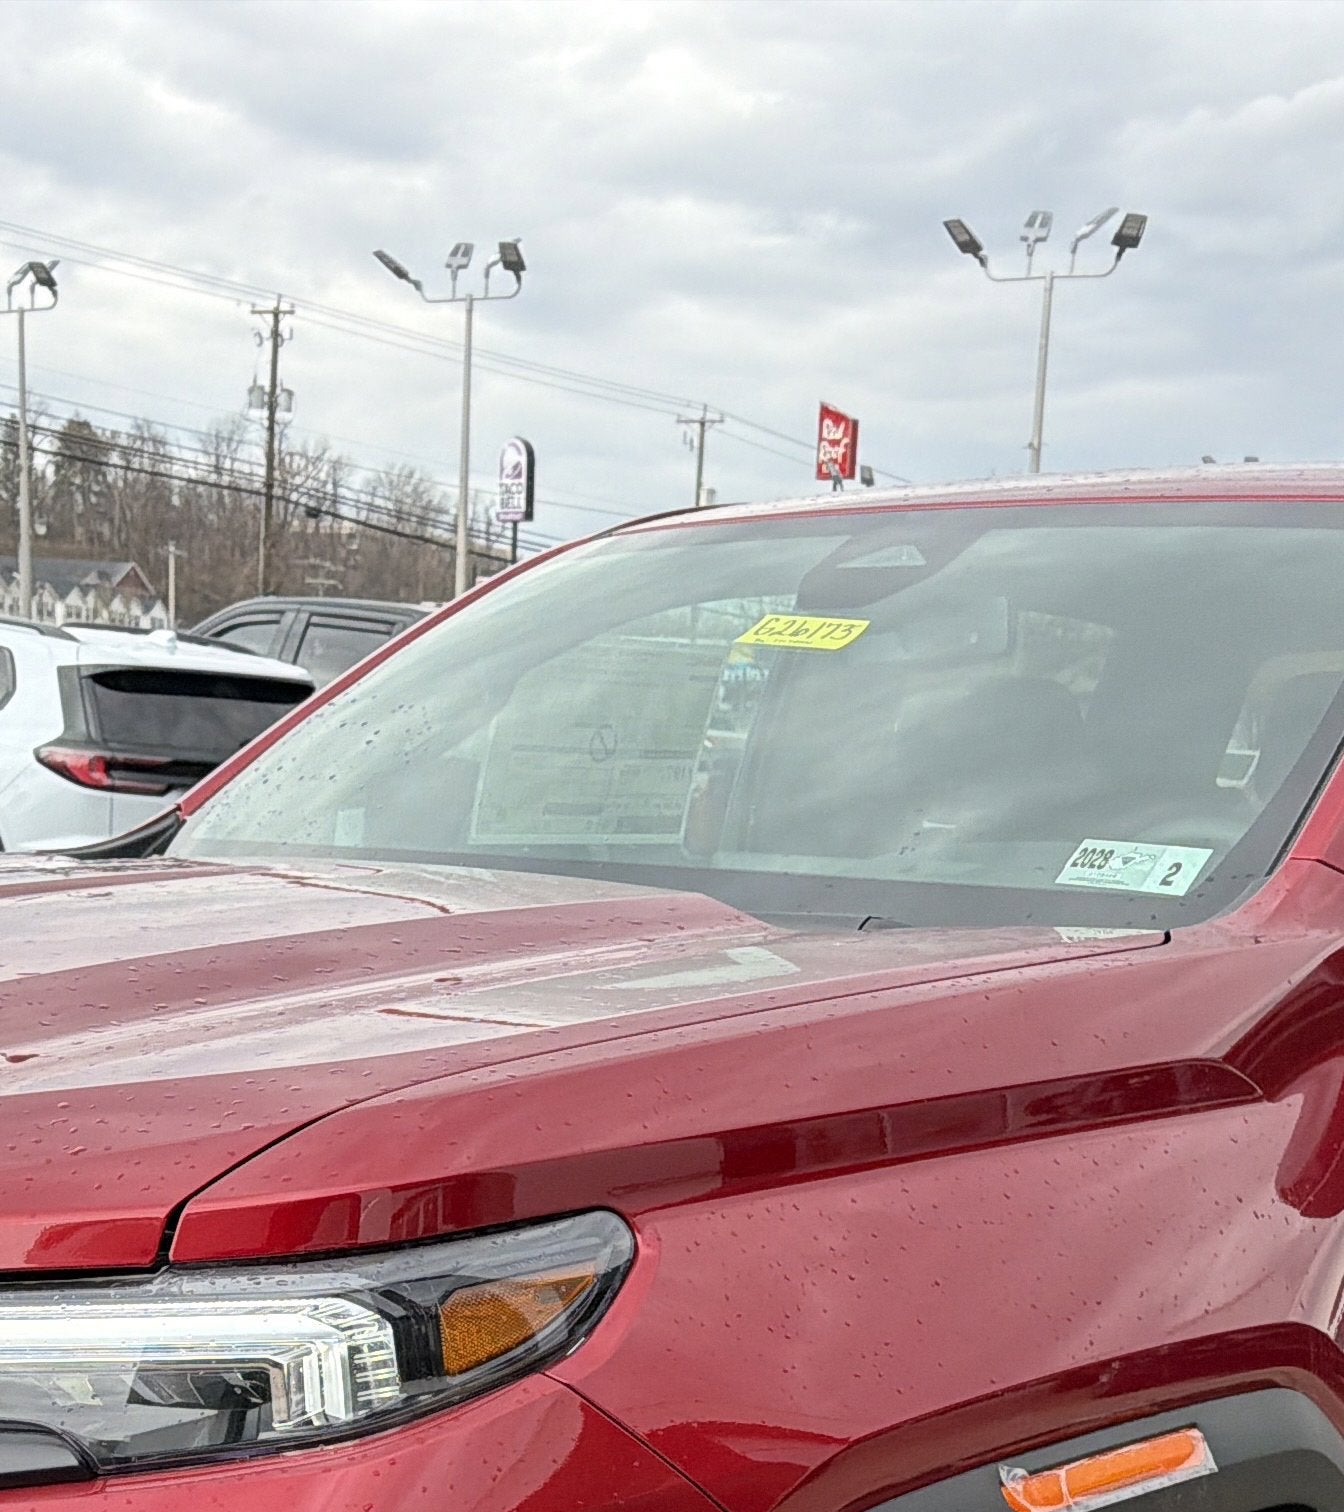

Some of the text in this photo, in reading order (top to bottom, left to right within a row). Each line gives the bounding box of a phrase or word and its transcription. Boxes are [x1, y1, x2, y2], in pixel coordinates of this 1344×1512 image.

[822, 418, 845, 439] Red
[819, 437, 850, 464] Roof
[499, 482, 523, 496] TACO
[500, 496, 523, 509] BELL
[1069, 846, 1116, 870] 2028
[1158, 861, 1184, 887] 2
